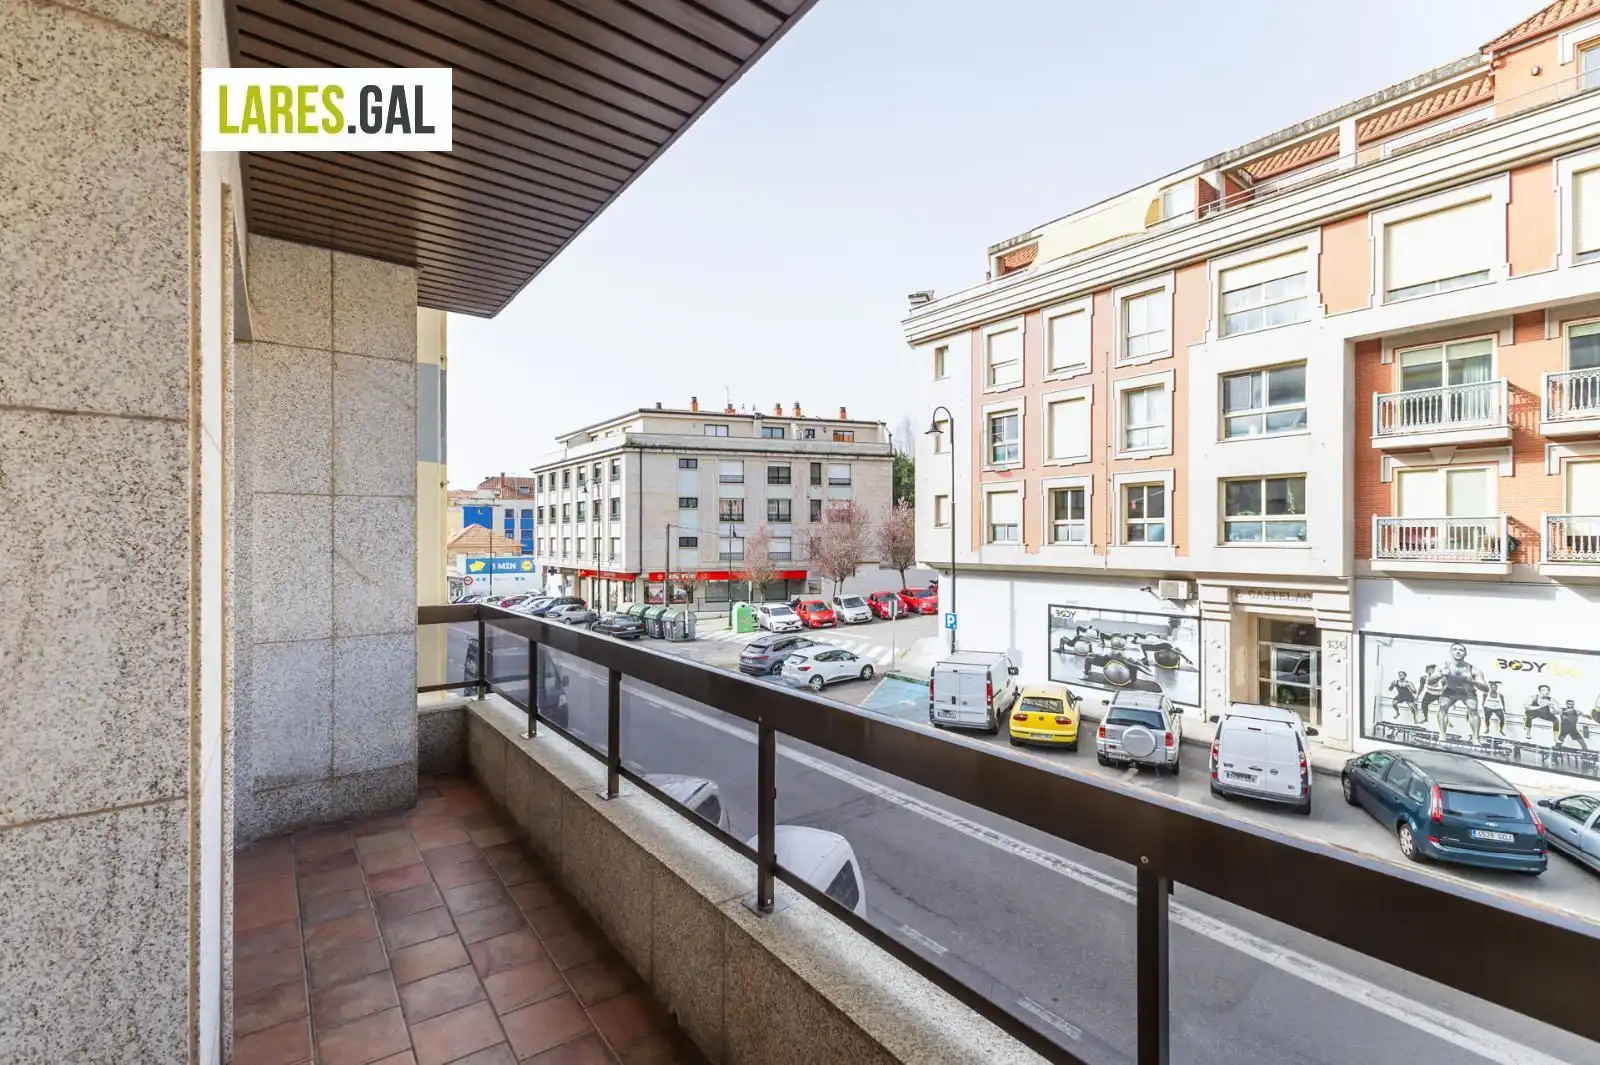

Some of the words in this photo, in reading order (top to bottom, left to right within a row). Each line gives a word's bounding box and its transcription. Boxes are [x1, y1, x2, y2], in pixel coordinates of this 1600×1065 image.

[498, 562, 516, 570] MIN
[946, 614, 956, 628] P
[1496, 658, 1548, 673] BODY
